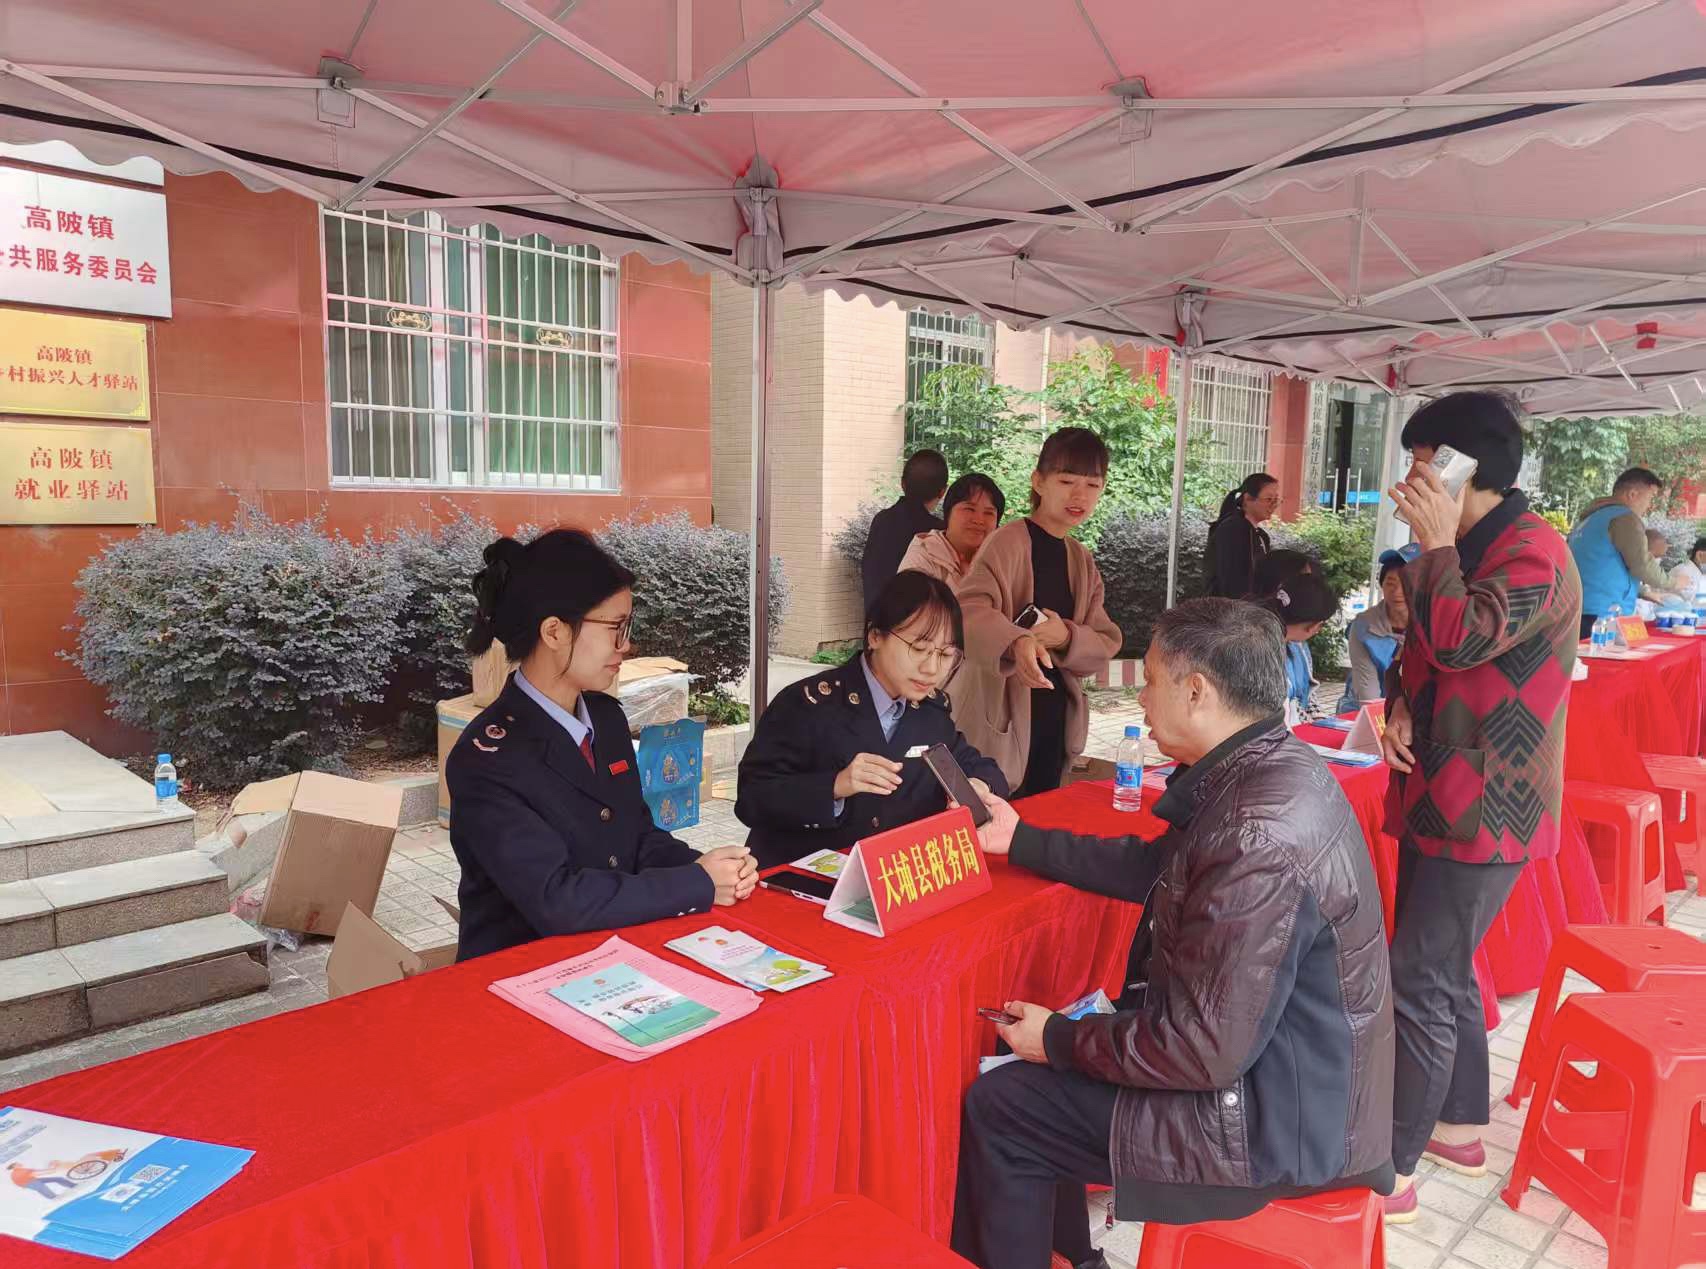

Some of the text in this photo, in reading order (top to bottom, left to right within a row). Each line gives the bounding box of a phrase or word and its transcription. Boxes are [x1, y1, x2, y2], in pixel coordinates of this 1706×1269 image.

[24, 205, 115, 240] 高陂镇
[36, 345, 93, 365] 高陂镇
[0, 364, 138, 391] 村振兴人才驿站
[30, 446, 113, 470] 高陂镇
[14, 478, 128, 501] 就业驿站
[877, 827, 980, 912] 大埔县税务局
